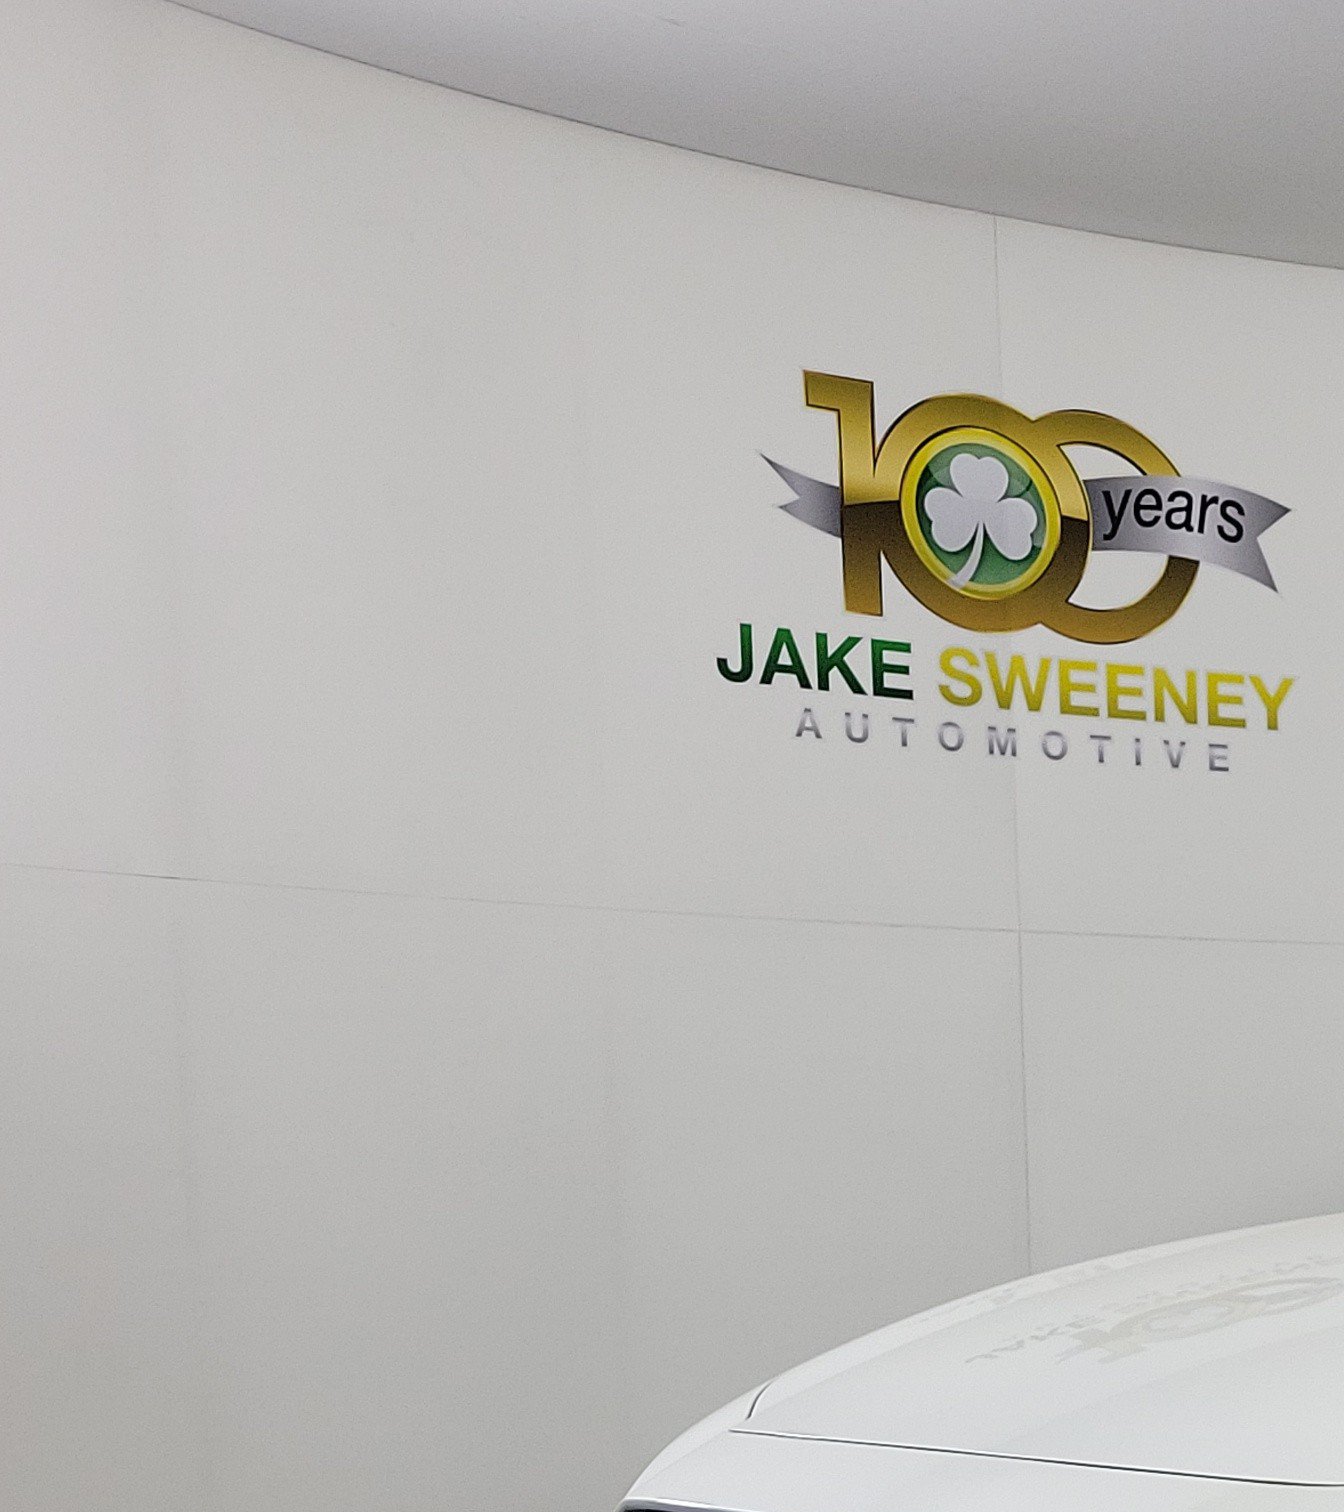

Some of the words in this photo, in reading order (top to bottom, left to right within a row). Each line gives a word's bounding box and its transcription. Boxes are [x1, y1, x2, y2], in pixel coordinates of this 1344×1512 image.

[803, 369, 1200, 645] 100
[1101, 486, 1246, 544] years
[715, 622, 915, 701] JAKE
[938, 647, 1296, 731] SWEENEY
[795, 707, 1231, 772] AUTOMOTIVE
